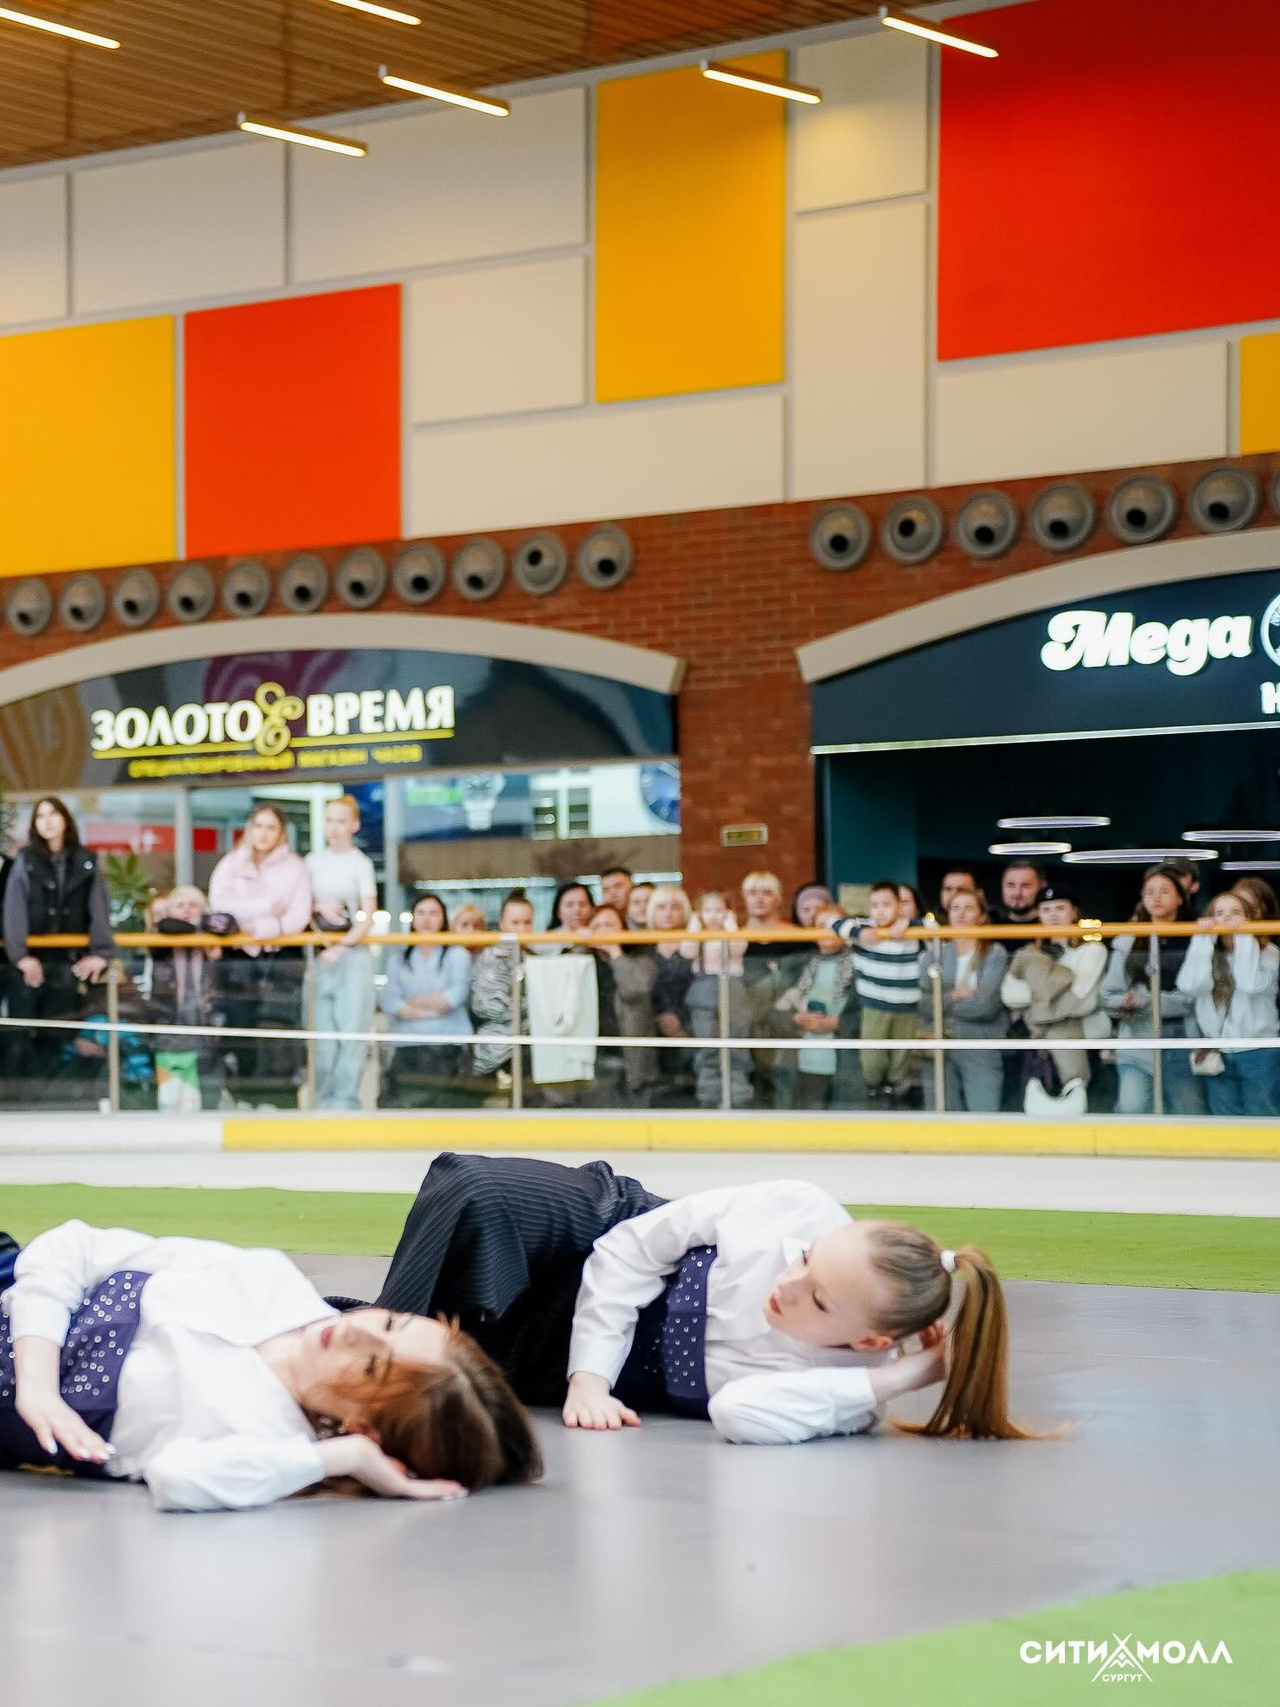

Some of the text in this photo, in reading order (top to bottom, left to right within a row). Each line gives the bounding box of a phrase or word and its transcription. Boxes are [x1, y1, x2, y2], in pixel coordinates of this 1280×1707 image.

[1040, 610, 1252, 676] Mega
[90, 700, 263, 751] ЗОЛОТО
[306, 685, 455, 738] ВРЕМЯ
